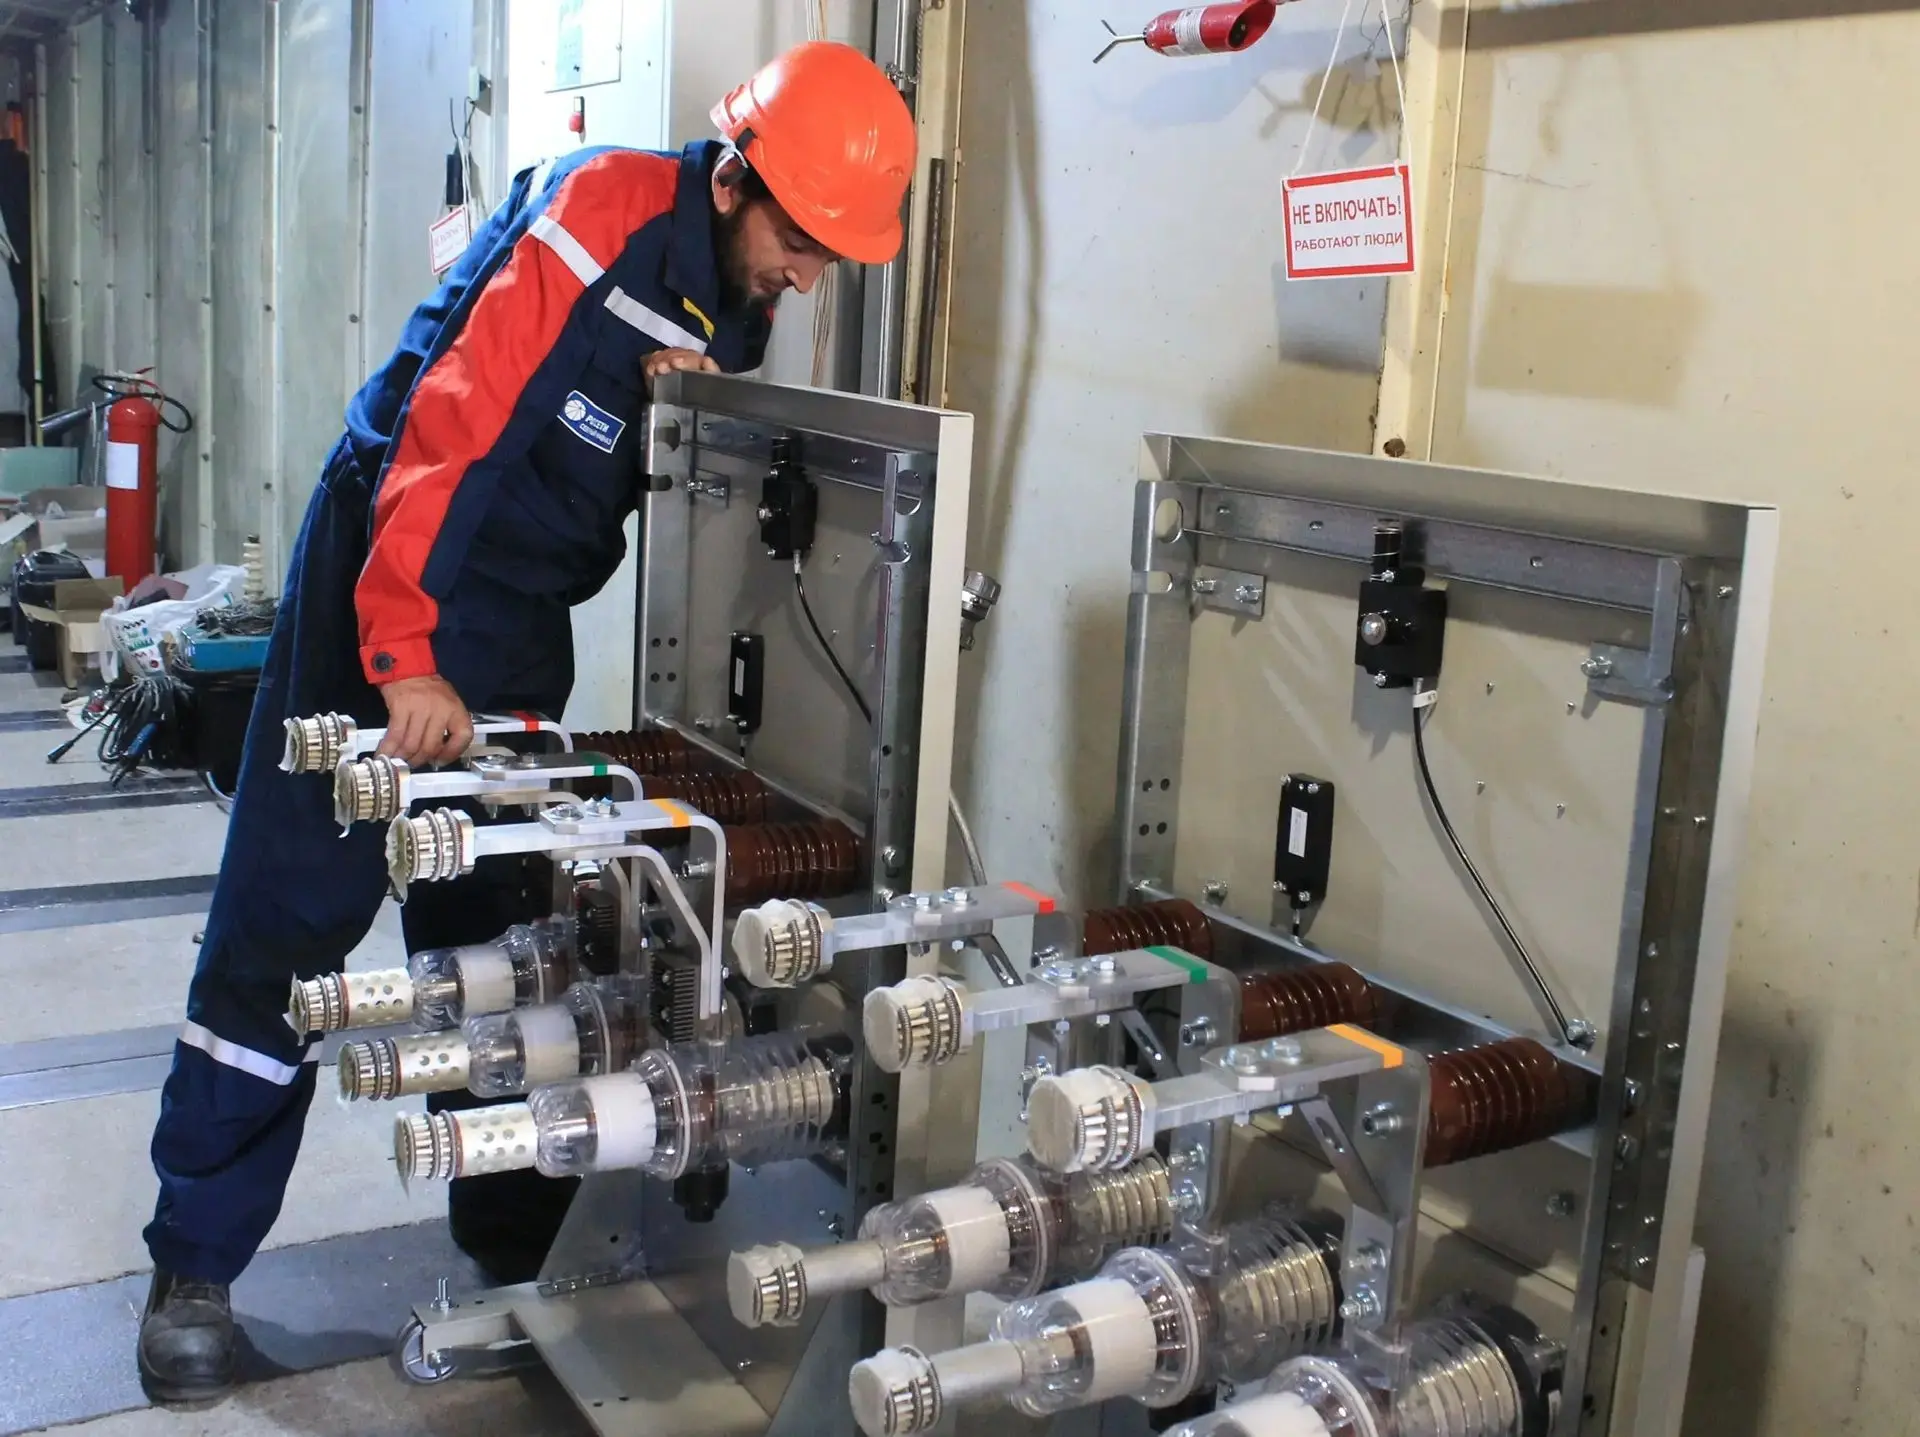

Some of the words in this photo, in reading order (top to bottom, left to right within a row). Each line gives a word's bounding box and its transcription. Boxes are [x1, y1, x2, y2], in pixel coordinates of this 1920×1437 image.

[1293, 204, 1311, 225] НЕ
[1315, 195, 1402, 223] ВКЛЮЧАТЬ!
[1294, 235, 1360, 251] РАБОТАЮТ
[1364, 232, 1403, 247] ЛЮДИ
